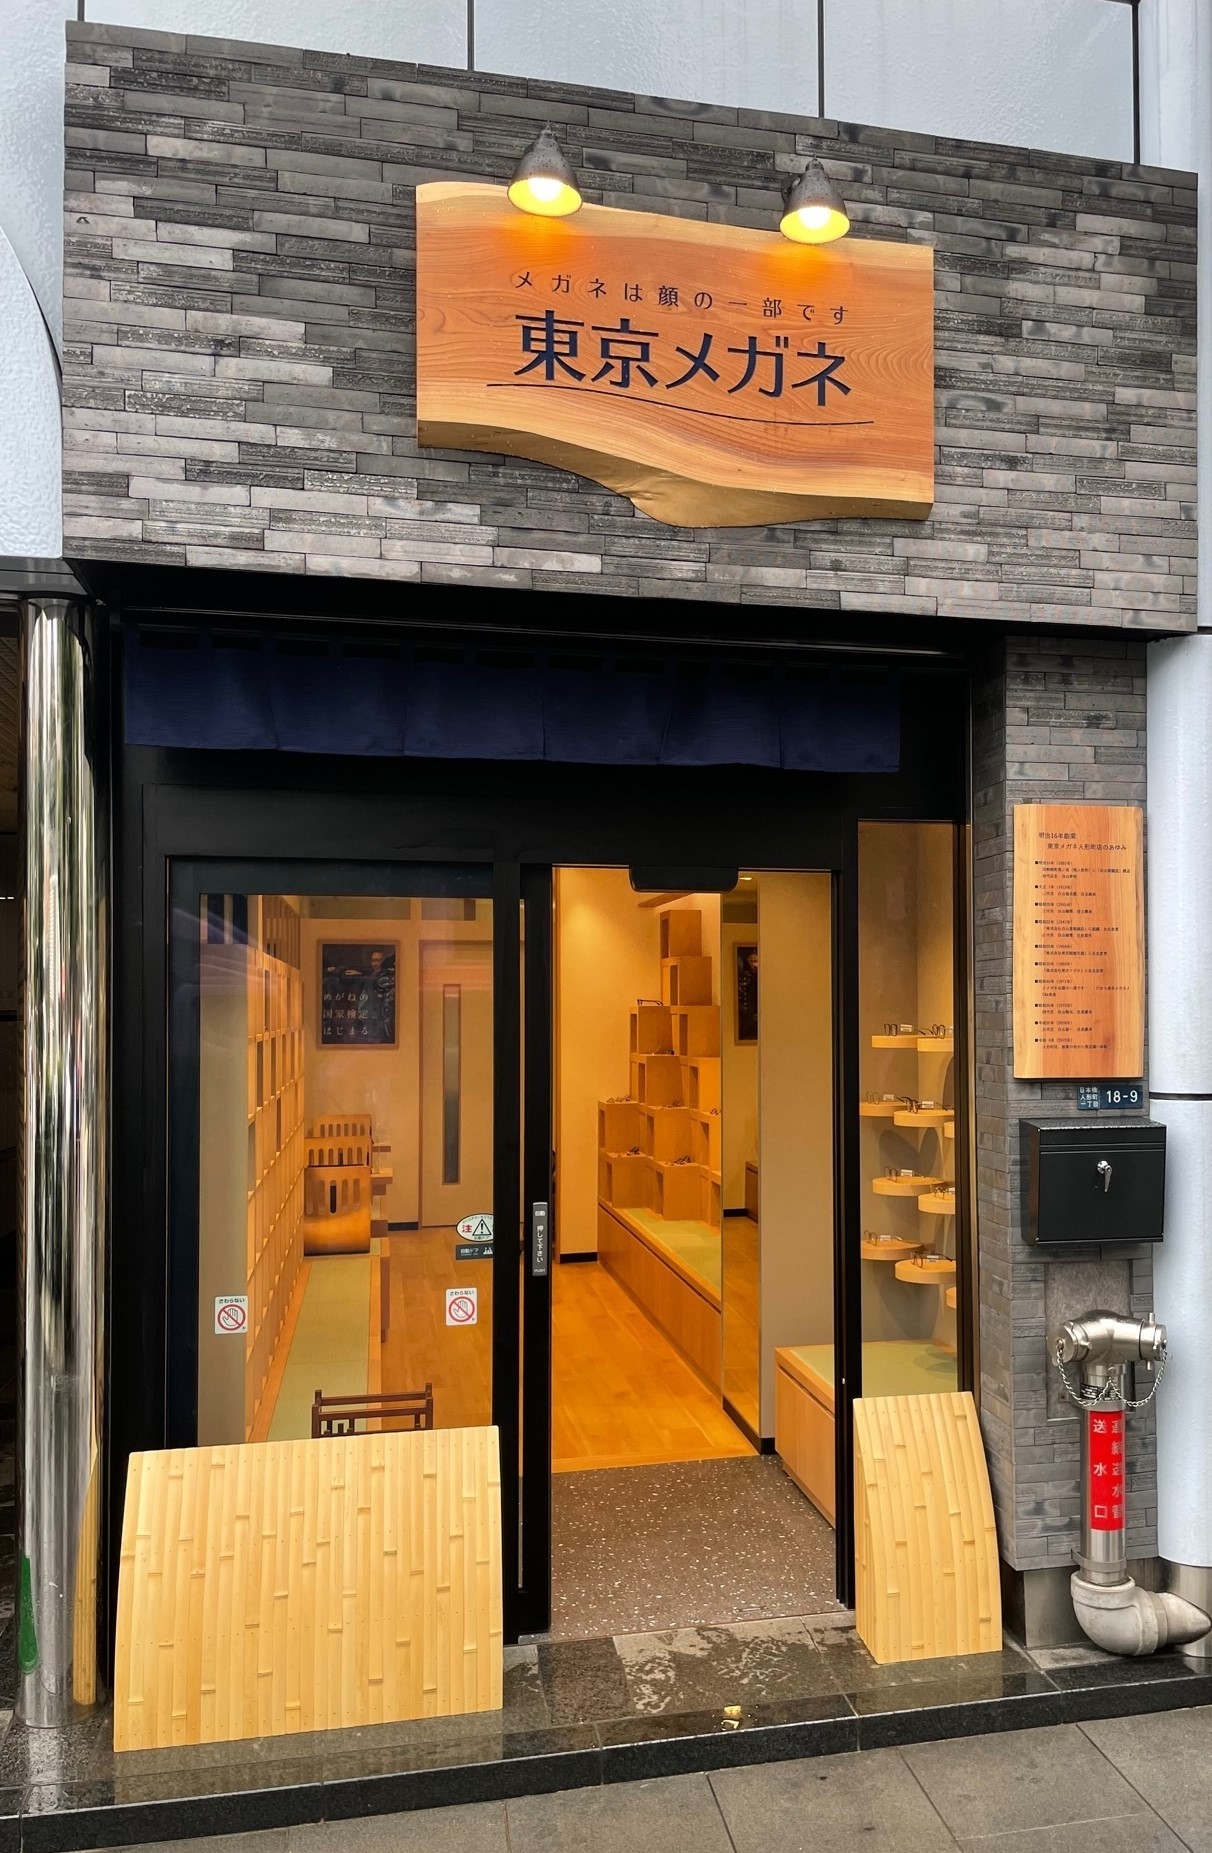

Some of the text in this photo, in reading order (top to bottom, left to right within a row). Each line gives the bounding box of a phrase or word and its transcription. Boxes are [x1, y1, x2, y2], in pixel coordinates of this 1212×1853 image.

[514, 271, 849, 325] メガネは顔の一部です
[514, 309, 852, 407] 東京メガネ
[1047, 843, 1127, 851] 東京メガネ人形町店のあゆみ
[323, 992, 369, 1002] めがねの
[323, 1026, 368, 1036] はじまる
[1080, 1086, 1098, 1094] 日本橋
[1080, 1093, 1098, 1101] 人形町
[1106, 1090, 1138, 1103] 18-9
[1093, 1419, 1108, 1519] 送水口
